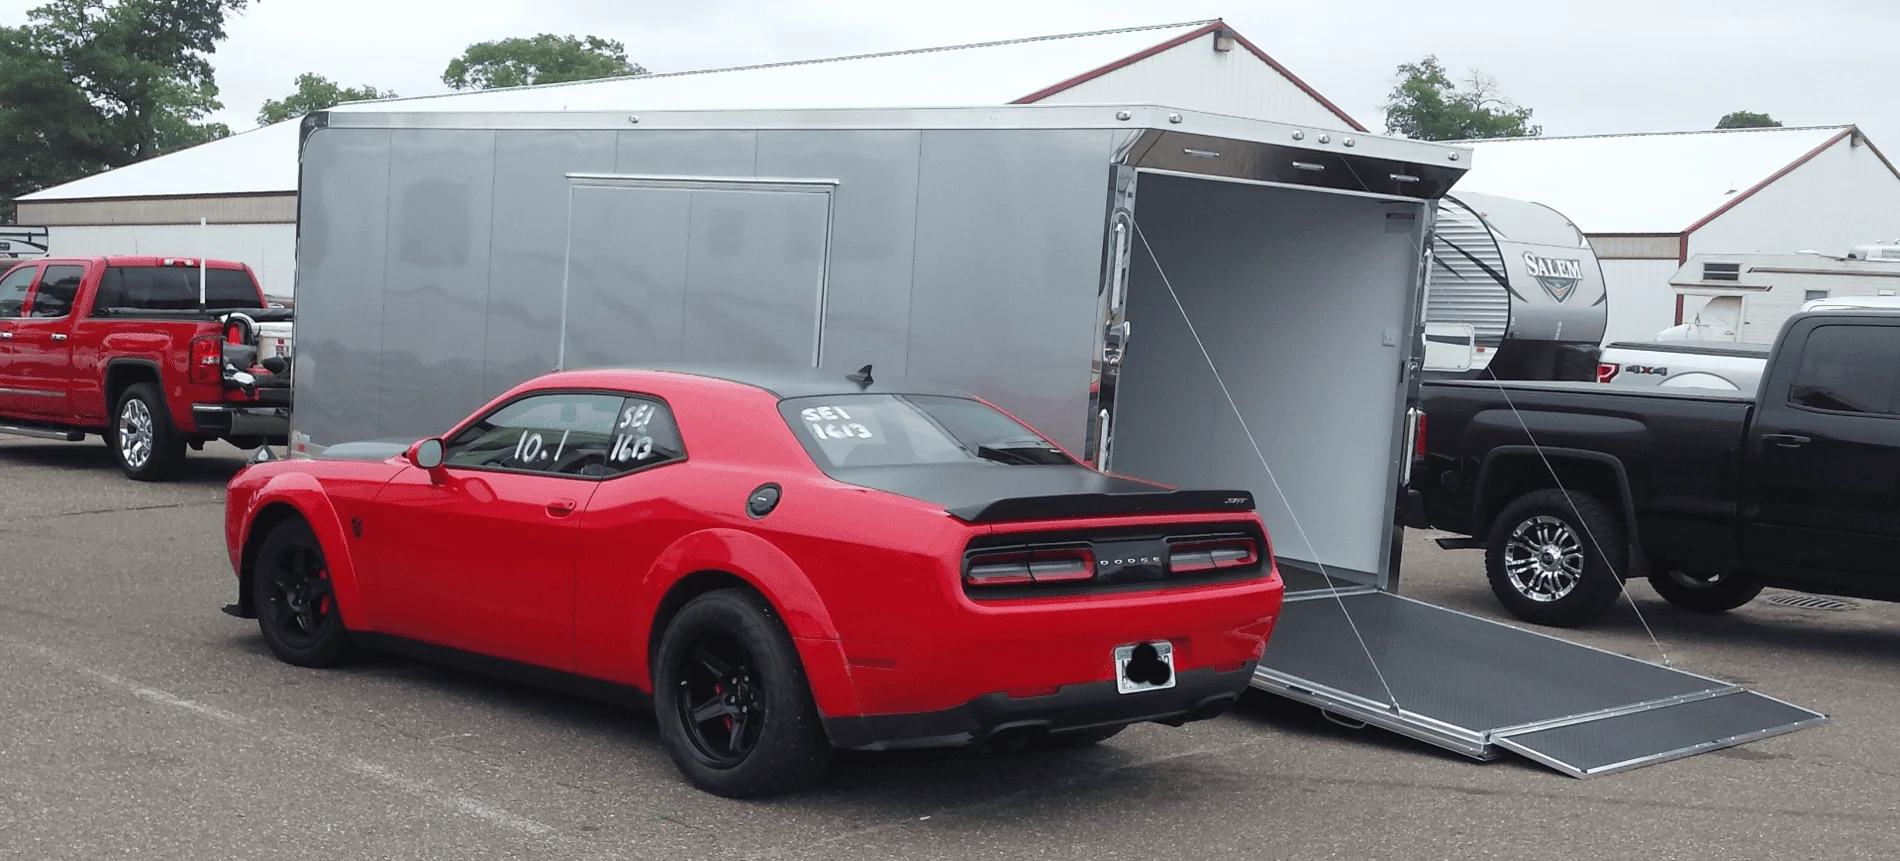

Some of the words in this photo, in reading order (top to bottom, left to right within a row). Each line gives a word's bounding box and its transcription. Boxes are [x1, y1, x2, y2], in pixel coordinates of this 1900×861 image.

[1523, 252, 1583, 279] SALEM
[812, 422, 873, 440] 1613
[514, 430, 569, 463] 10.1
[610, 433, 653, 463] 1613
[1100, 556, 1160, 566] DODGE
